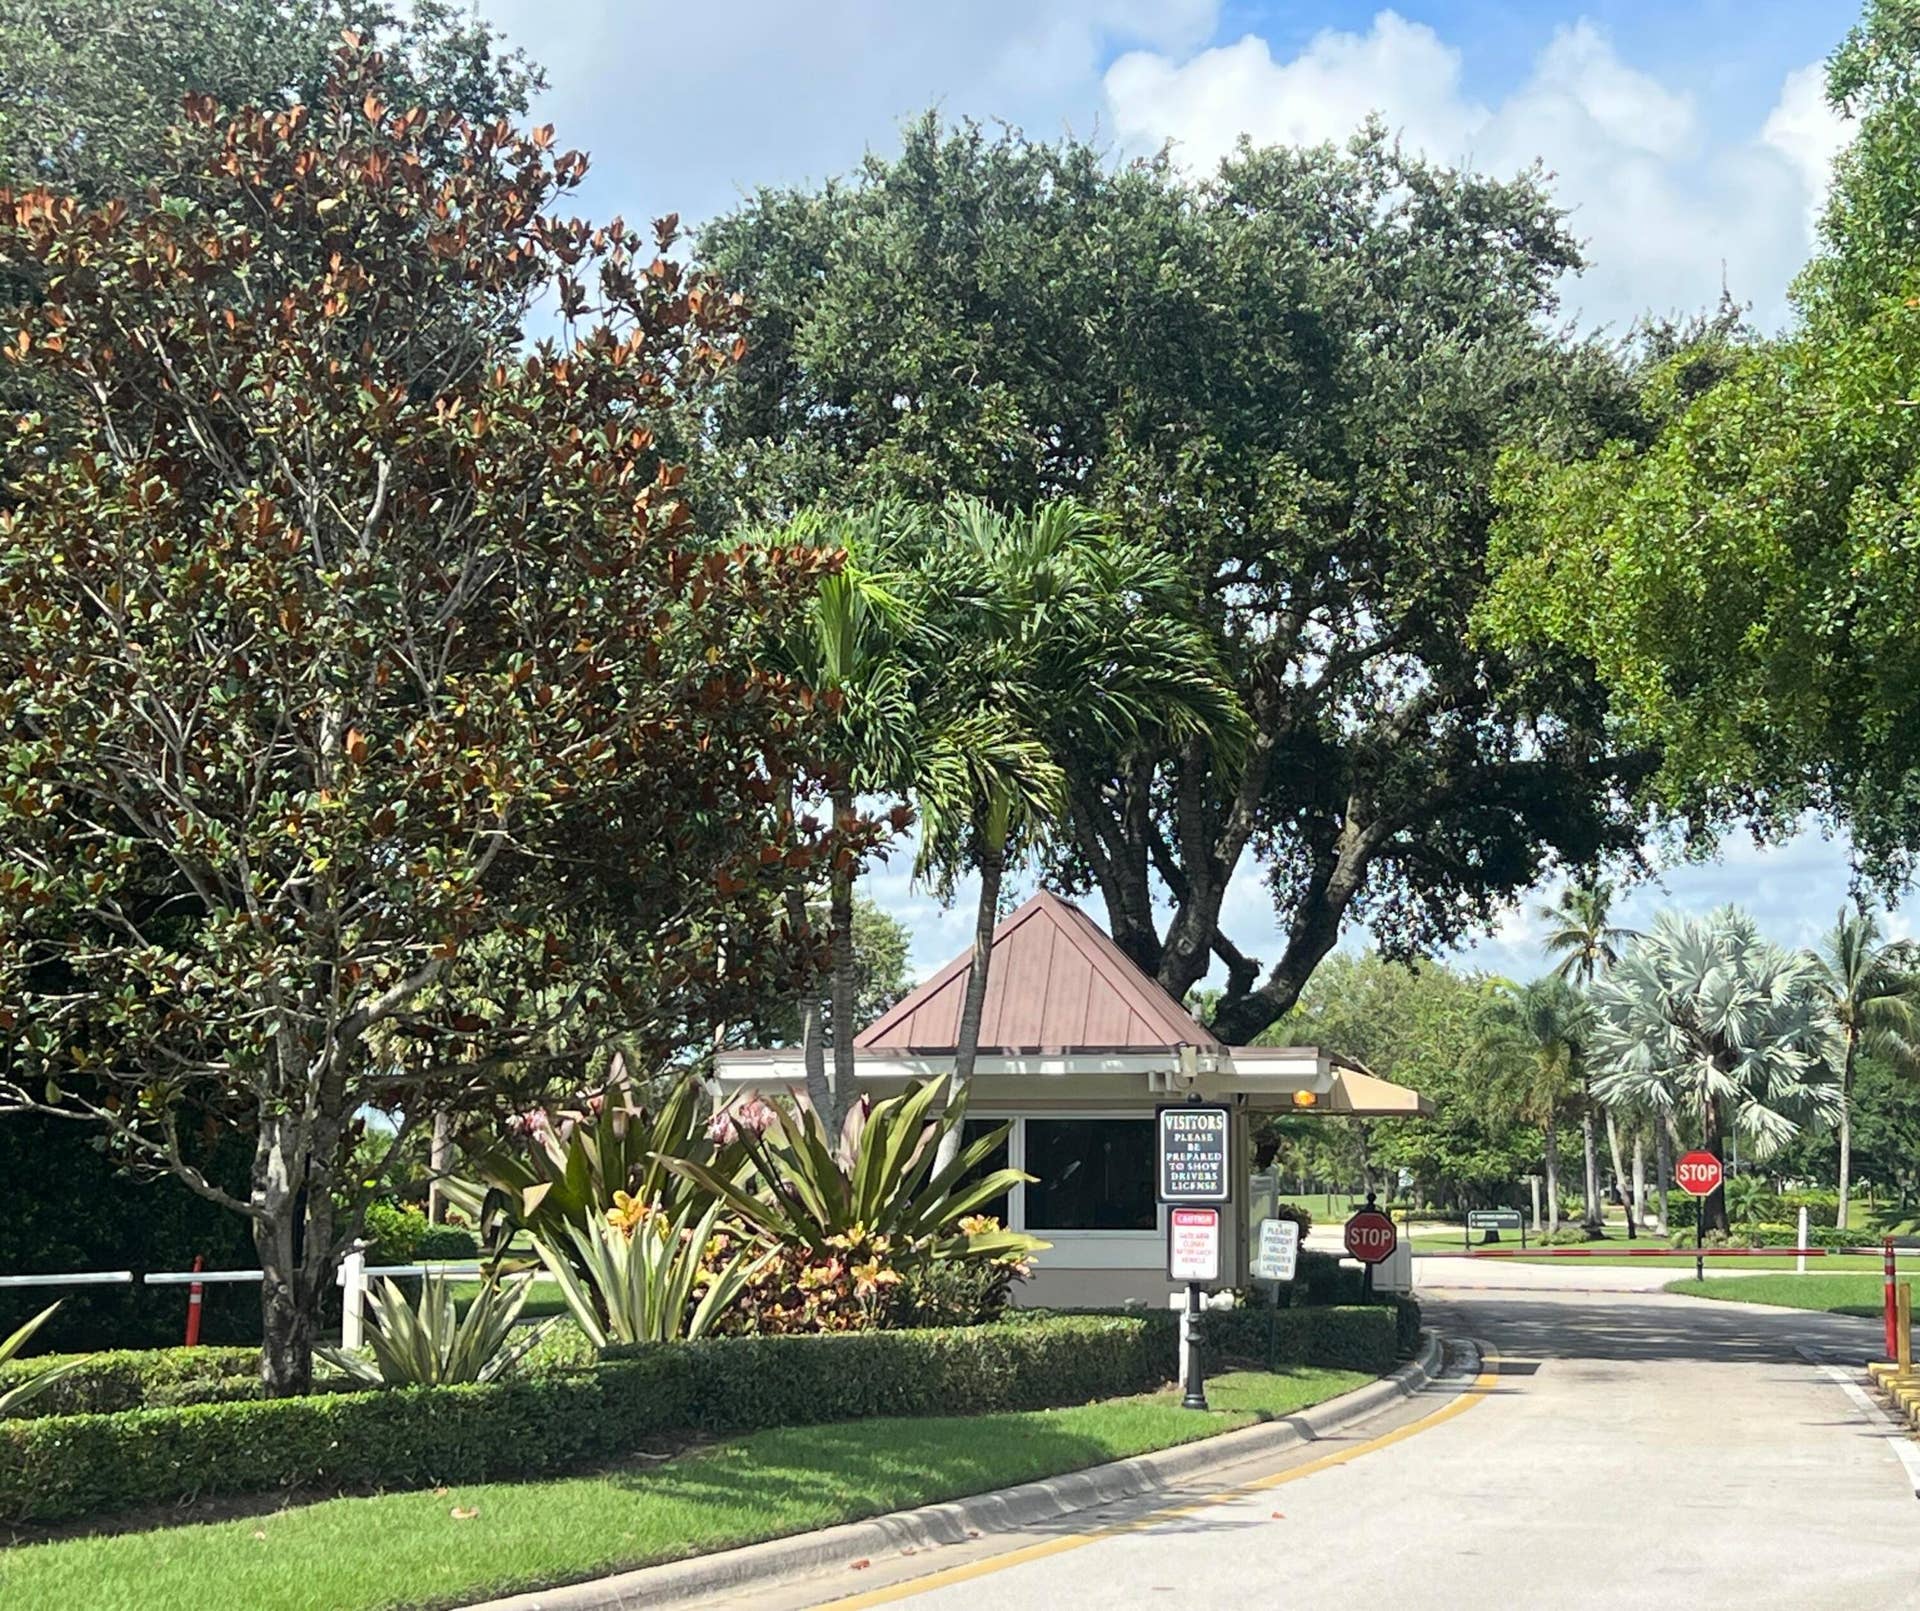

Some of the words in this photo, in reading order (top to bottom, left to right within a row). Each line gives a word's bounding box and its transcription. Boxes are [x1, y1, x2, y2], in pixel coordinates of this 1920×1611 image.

[1165, 1115, 1223, 1130] VISITORS
[1174, 1133, 1214, 1142] PLEASE
[1187, 1143, 1200, 1151] BE
[1166, 1152, 1222, 1161] PREPARED
[1168, 1162, 1185, 1171] TO
[1187, 1162, 1219, 1171] SHOW
[1170, 1172, 1218, 1181] DRIVERS
[1679, 1164, 1718, 1181] STOP
[1171, 1181, 1217, 1190] LICENSE
[1176, 1214, 1212, 1224] CAUTION
[1267, 1227, 1292, 1236] PLEASE
[1350, 1227, 1391, 1247] STOP
